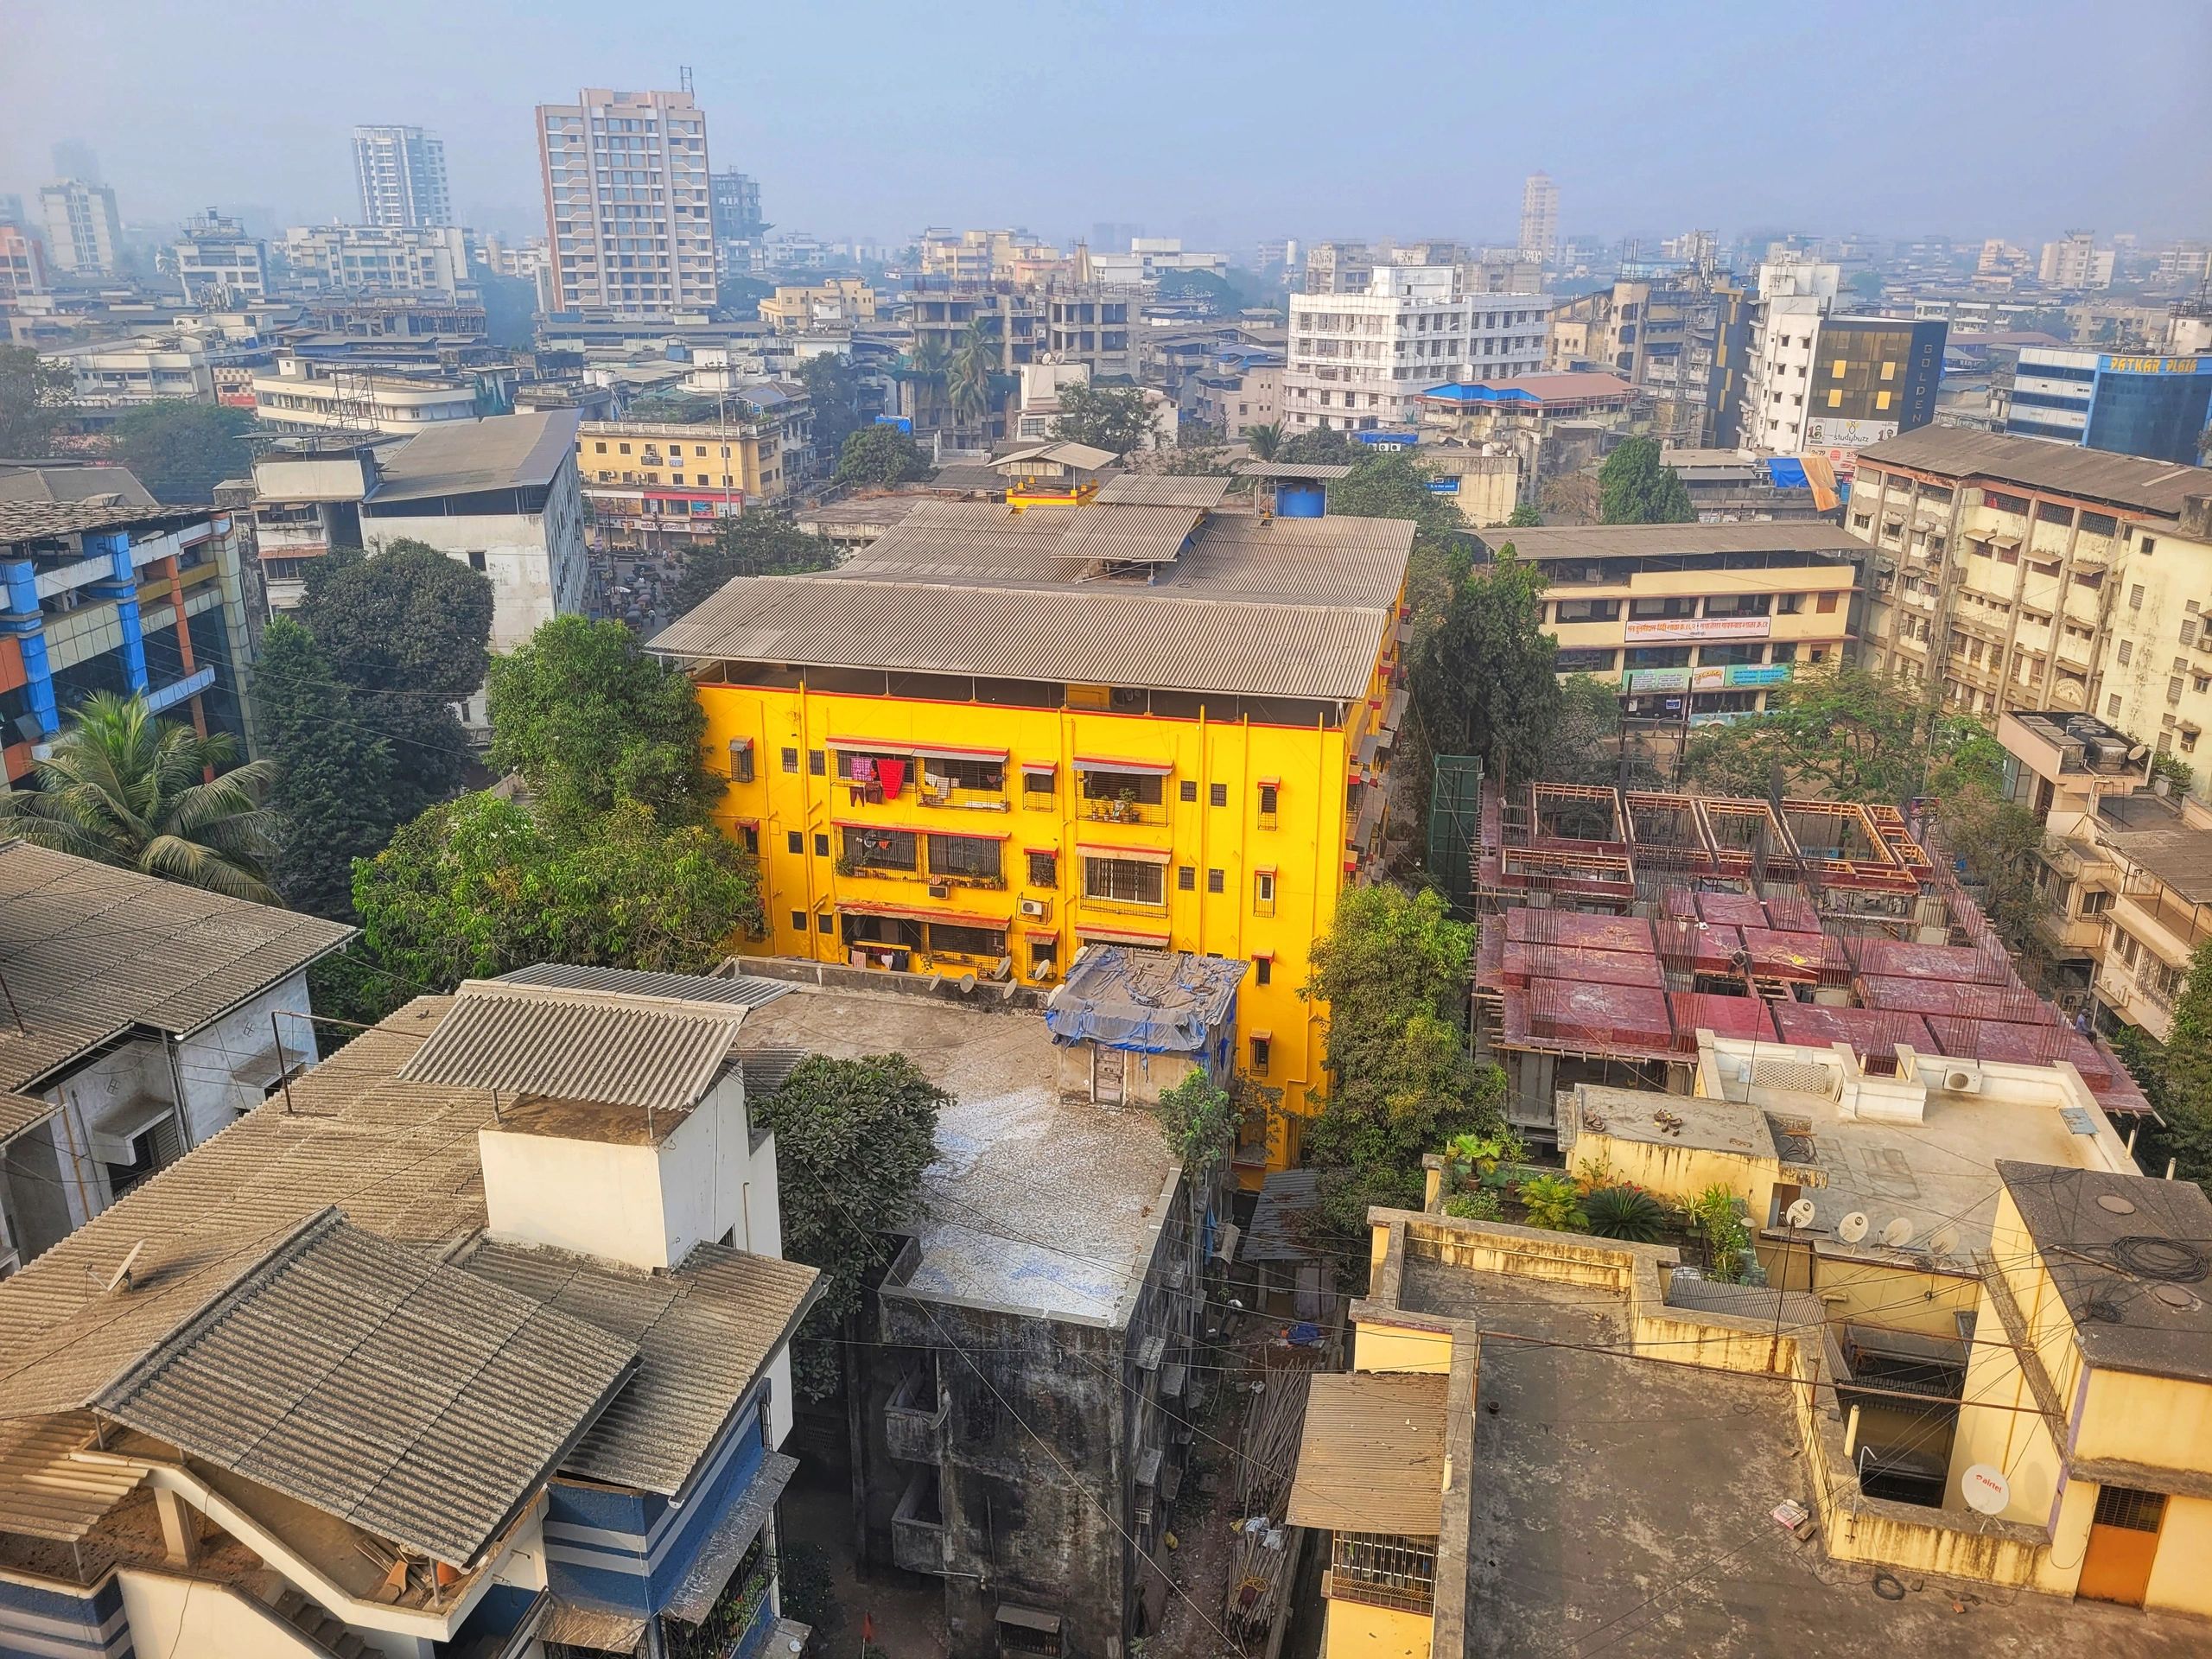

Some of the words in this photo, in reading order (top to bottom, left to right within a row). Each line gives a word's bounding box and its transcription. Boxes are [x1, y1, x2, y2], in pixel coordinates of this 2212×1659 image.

[2111, 357, 2160, 373] PATKAR
[2165, 358, 2197, 373] PLAZA
[1912, 344, 1933, 423] GOLDEN
[1834, 434, 1869, 443] studybuzz
[1982, 1478, 2002, 1493] airtel
